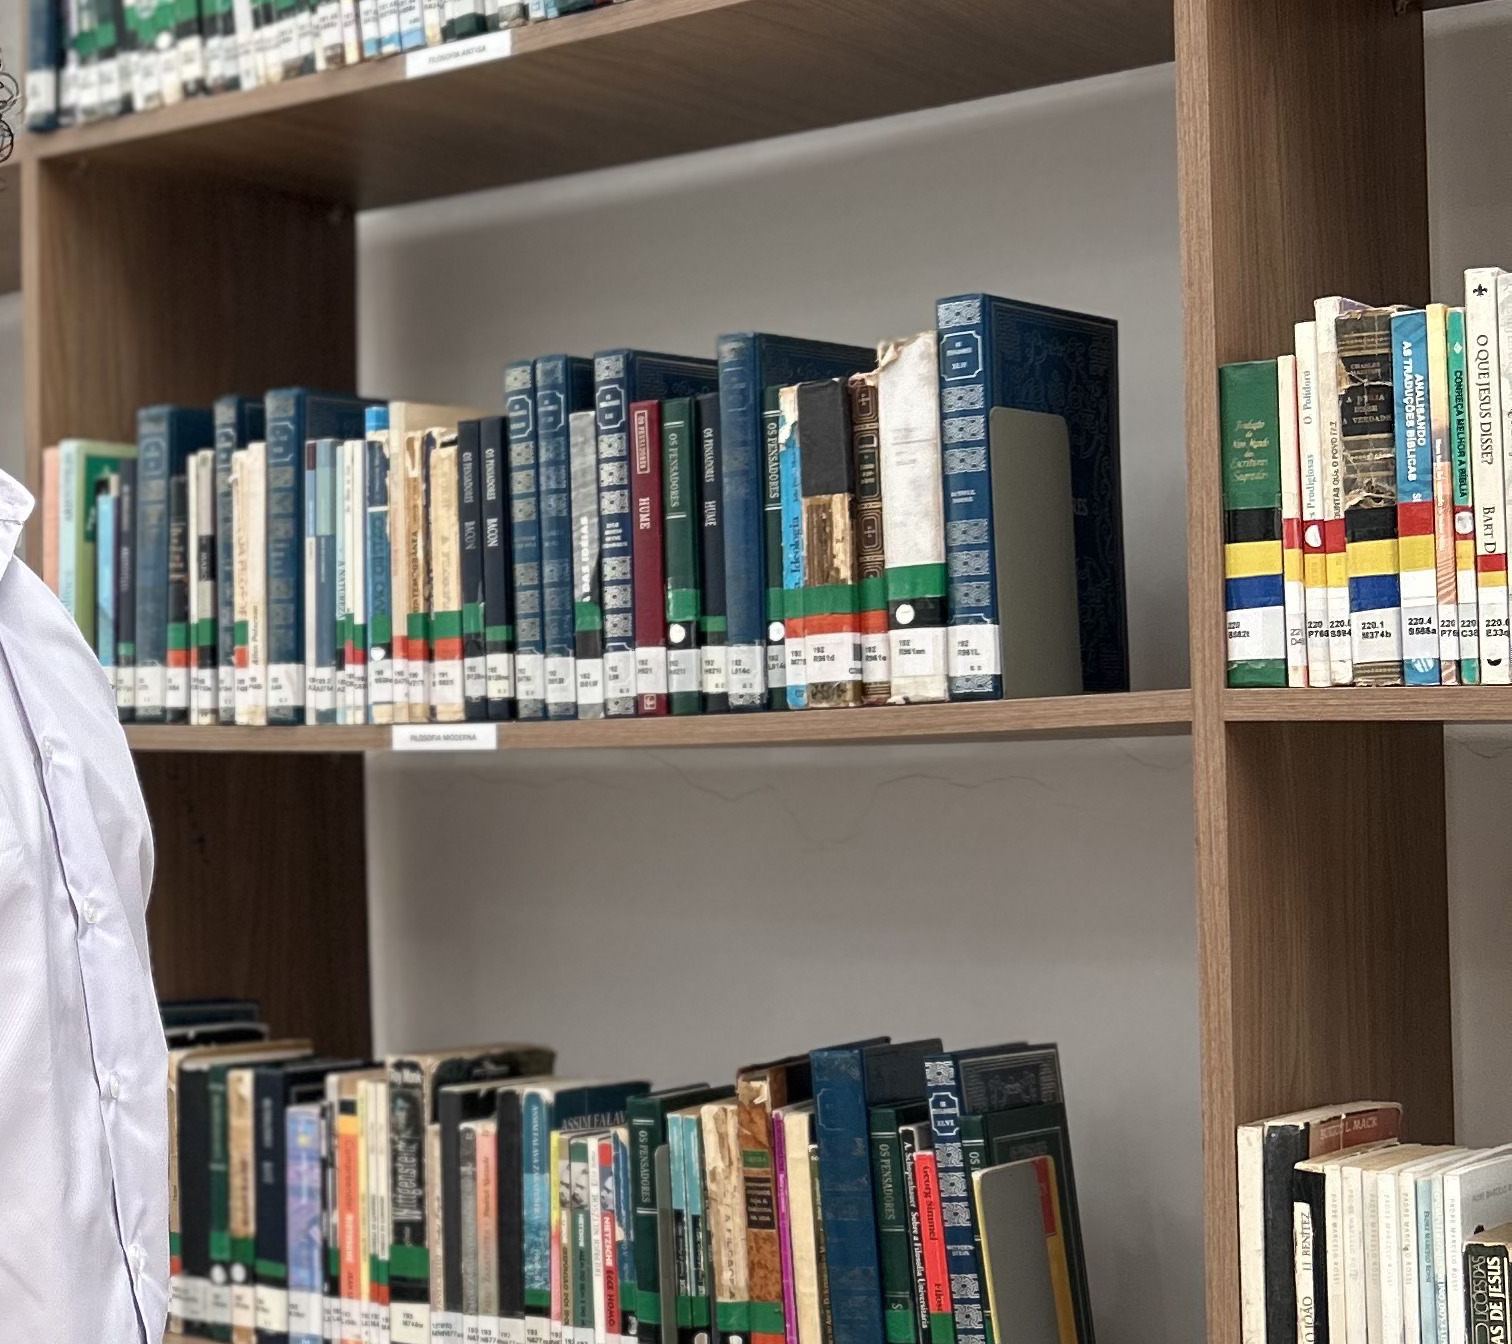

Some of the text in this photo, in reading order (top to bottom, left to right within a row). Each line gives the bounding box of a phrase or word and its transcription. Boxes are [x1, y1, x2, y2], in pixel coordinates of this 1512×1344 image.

[1402, 341, 1412, 357] AS
[1403, 358, 1415, 427] TRADUÇÕES
[1475, 334, 1494, 466] O QUE JESUS DISSE?
[1414, 373, 1426, 446] ANALISANDO
[767, 422, 780, 499] OS PENSADORES
[638, 496, 650, 530] HUME
[704, 499, 717, 528] HUME
[1482, 506, 1496, 538] BART
[486, 517, 498, 548] BACON
[1408, 617, 1432, 625] 220.4
[561, 1111, 627, 1131] ASSIM FALAV
[1353, 1116, 1378, 1129] MACK
[639, 1130, 650, 1204] OS PENSADORES
[879, 1144, 895, 1220] OS PENSADORES
[1487, 1257, 1505, 1299] JESUS
[606, 1297, 616, 1327] HOMO
[1489, 1302, 1503, 1321] DE
